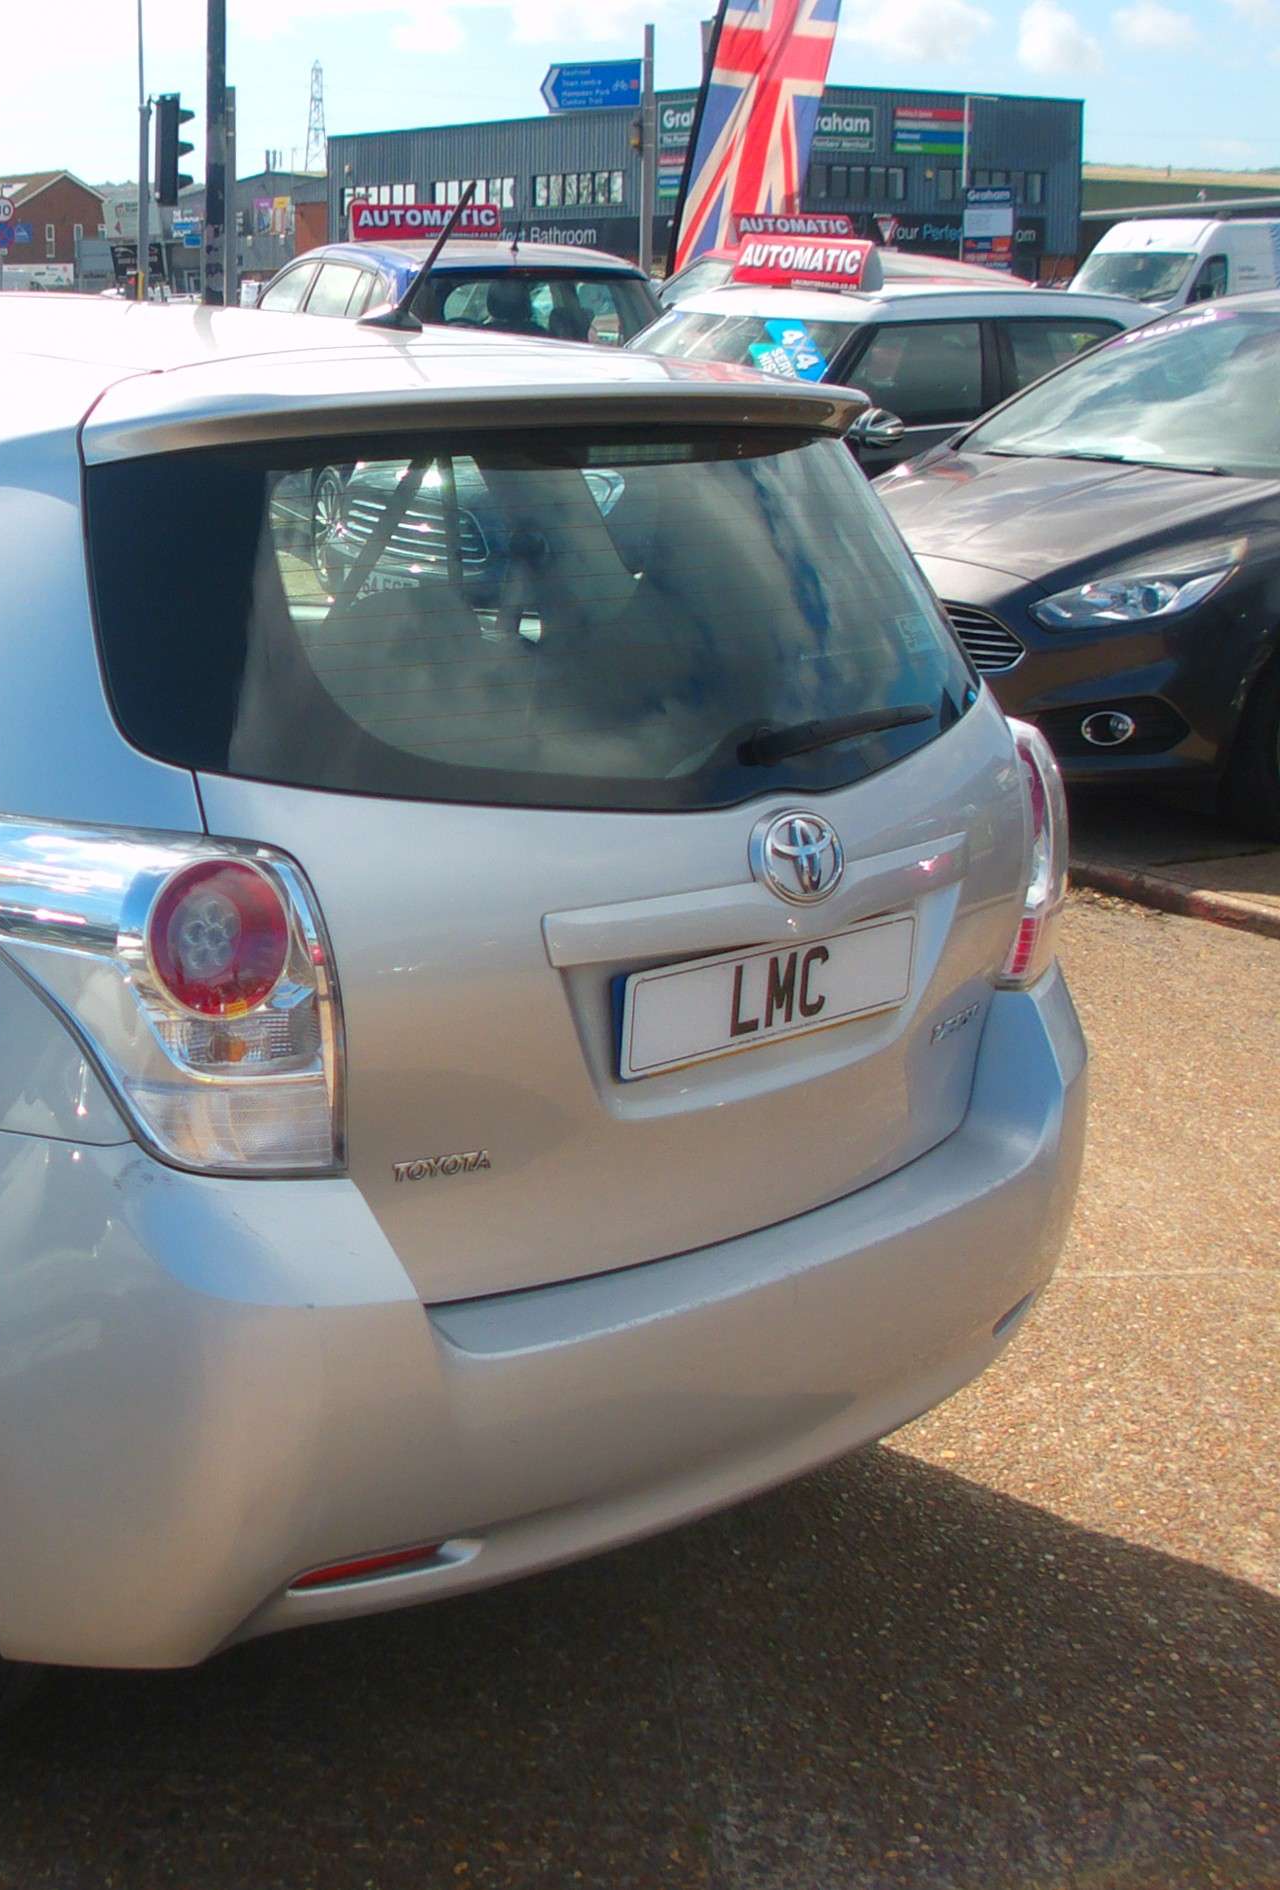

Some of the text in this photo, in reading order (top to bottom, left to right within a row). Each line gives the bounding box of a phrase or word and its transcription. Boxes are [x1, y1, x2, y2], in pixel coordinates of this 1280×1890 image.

[663, 106, 695, 128] Gra
[815, 112, 870, 133] raham
[967, 190, 1011, 201] Graham
[358, 208, 497, 228] AUTOMATIC
[739, 217, 849, 234] AUTOMATIC
[530, 226, 597, 245] Bathroom
[923, 224, 962, 241] Perfe
[739, 243, 862, 275] AUTOMATIC
[771, 347, 798, 378] SERV
[729, 945, 829, 1038] LMC
[392, 1149, 492, 1182] TOYOTA
